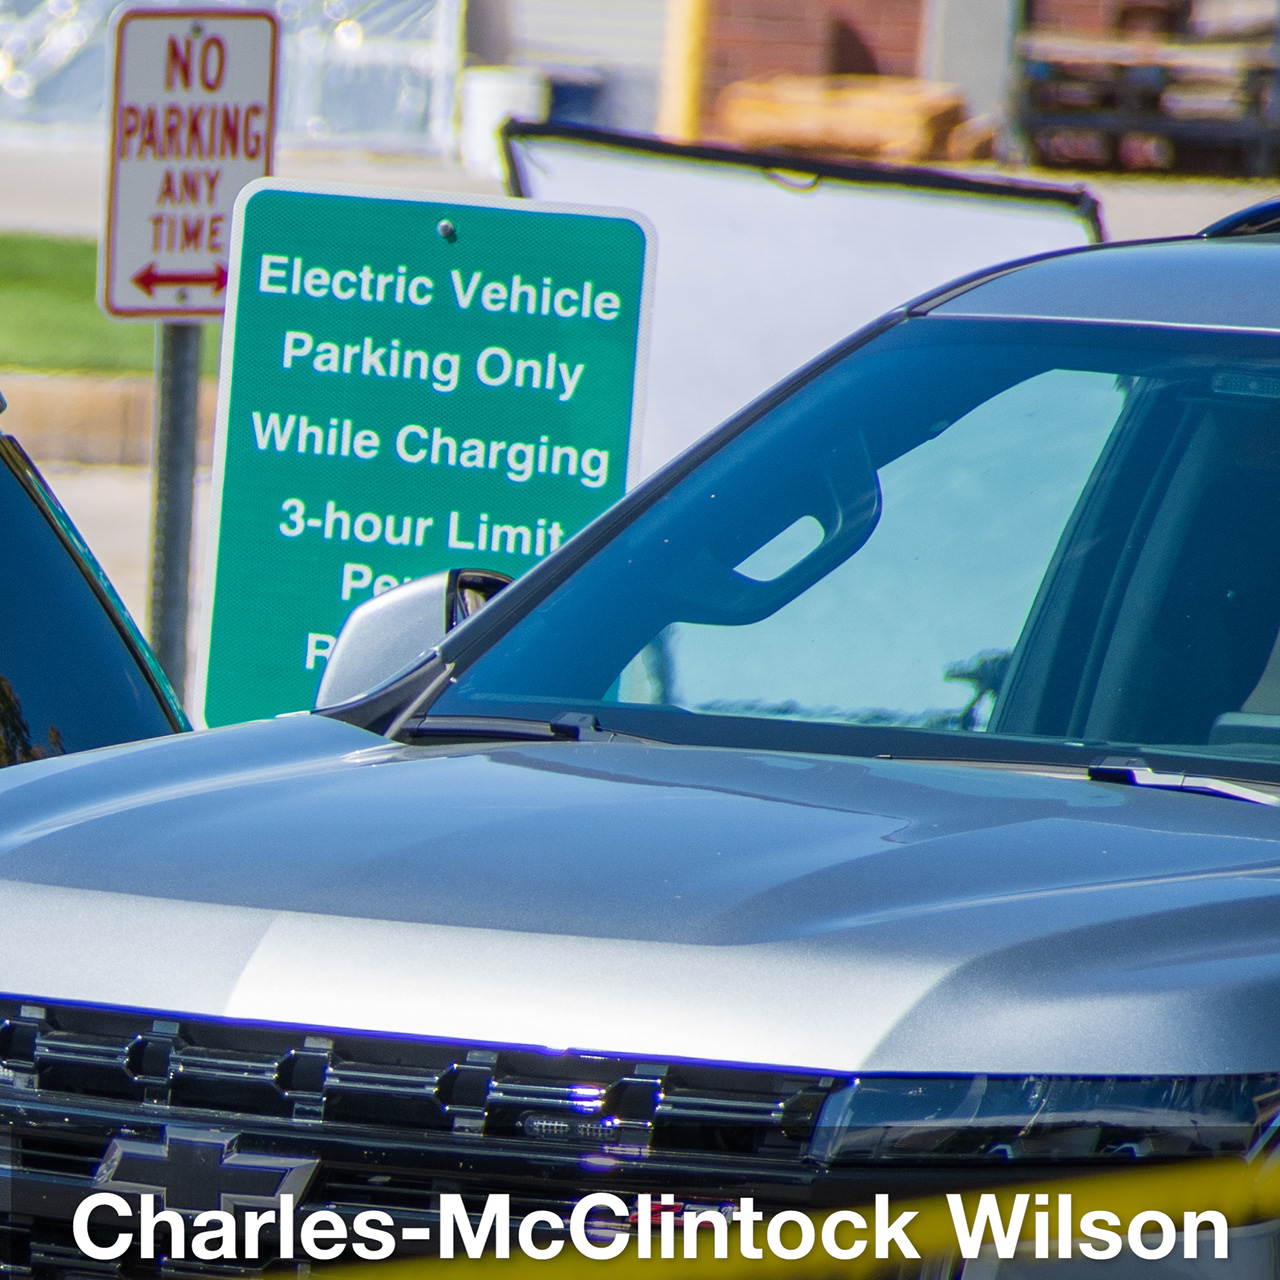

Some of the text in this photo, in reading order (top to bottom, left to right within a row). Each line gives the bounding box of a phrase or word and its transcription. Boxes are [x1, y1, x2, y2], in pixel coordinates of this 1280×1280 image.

[164, 34, 228, 92] NO
[118, 103, 264, 162] PARKING
[157, 169, 221, 207] ANY
[150, 213, 225, 254] TIME
[259, 254, 621, 320] Electric Vehicle
[283, 331, 585, 401] Parking Only
[252, 411, 609, 488] While Charging
[279, 498, 565, 556] 3-hour Limit
